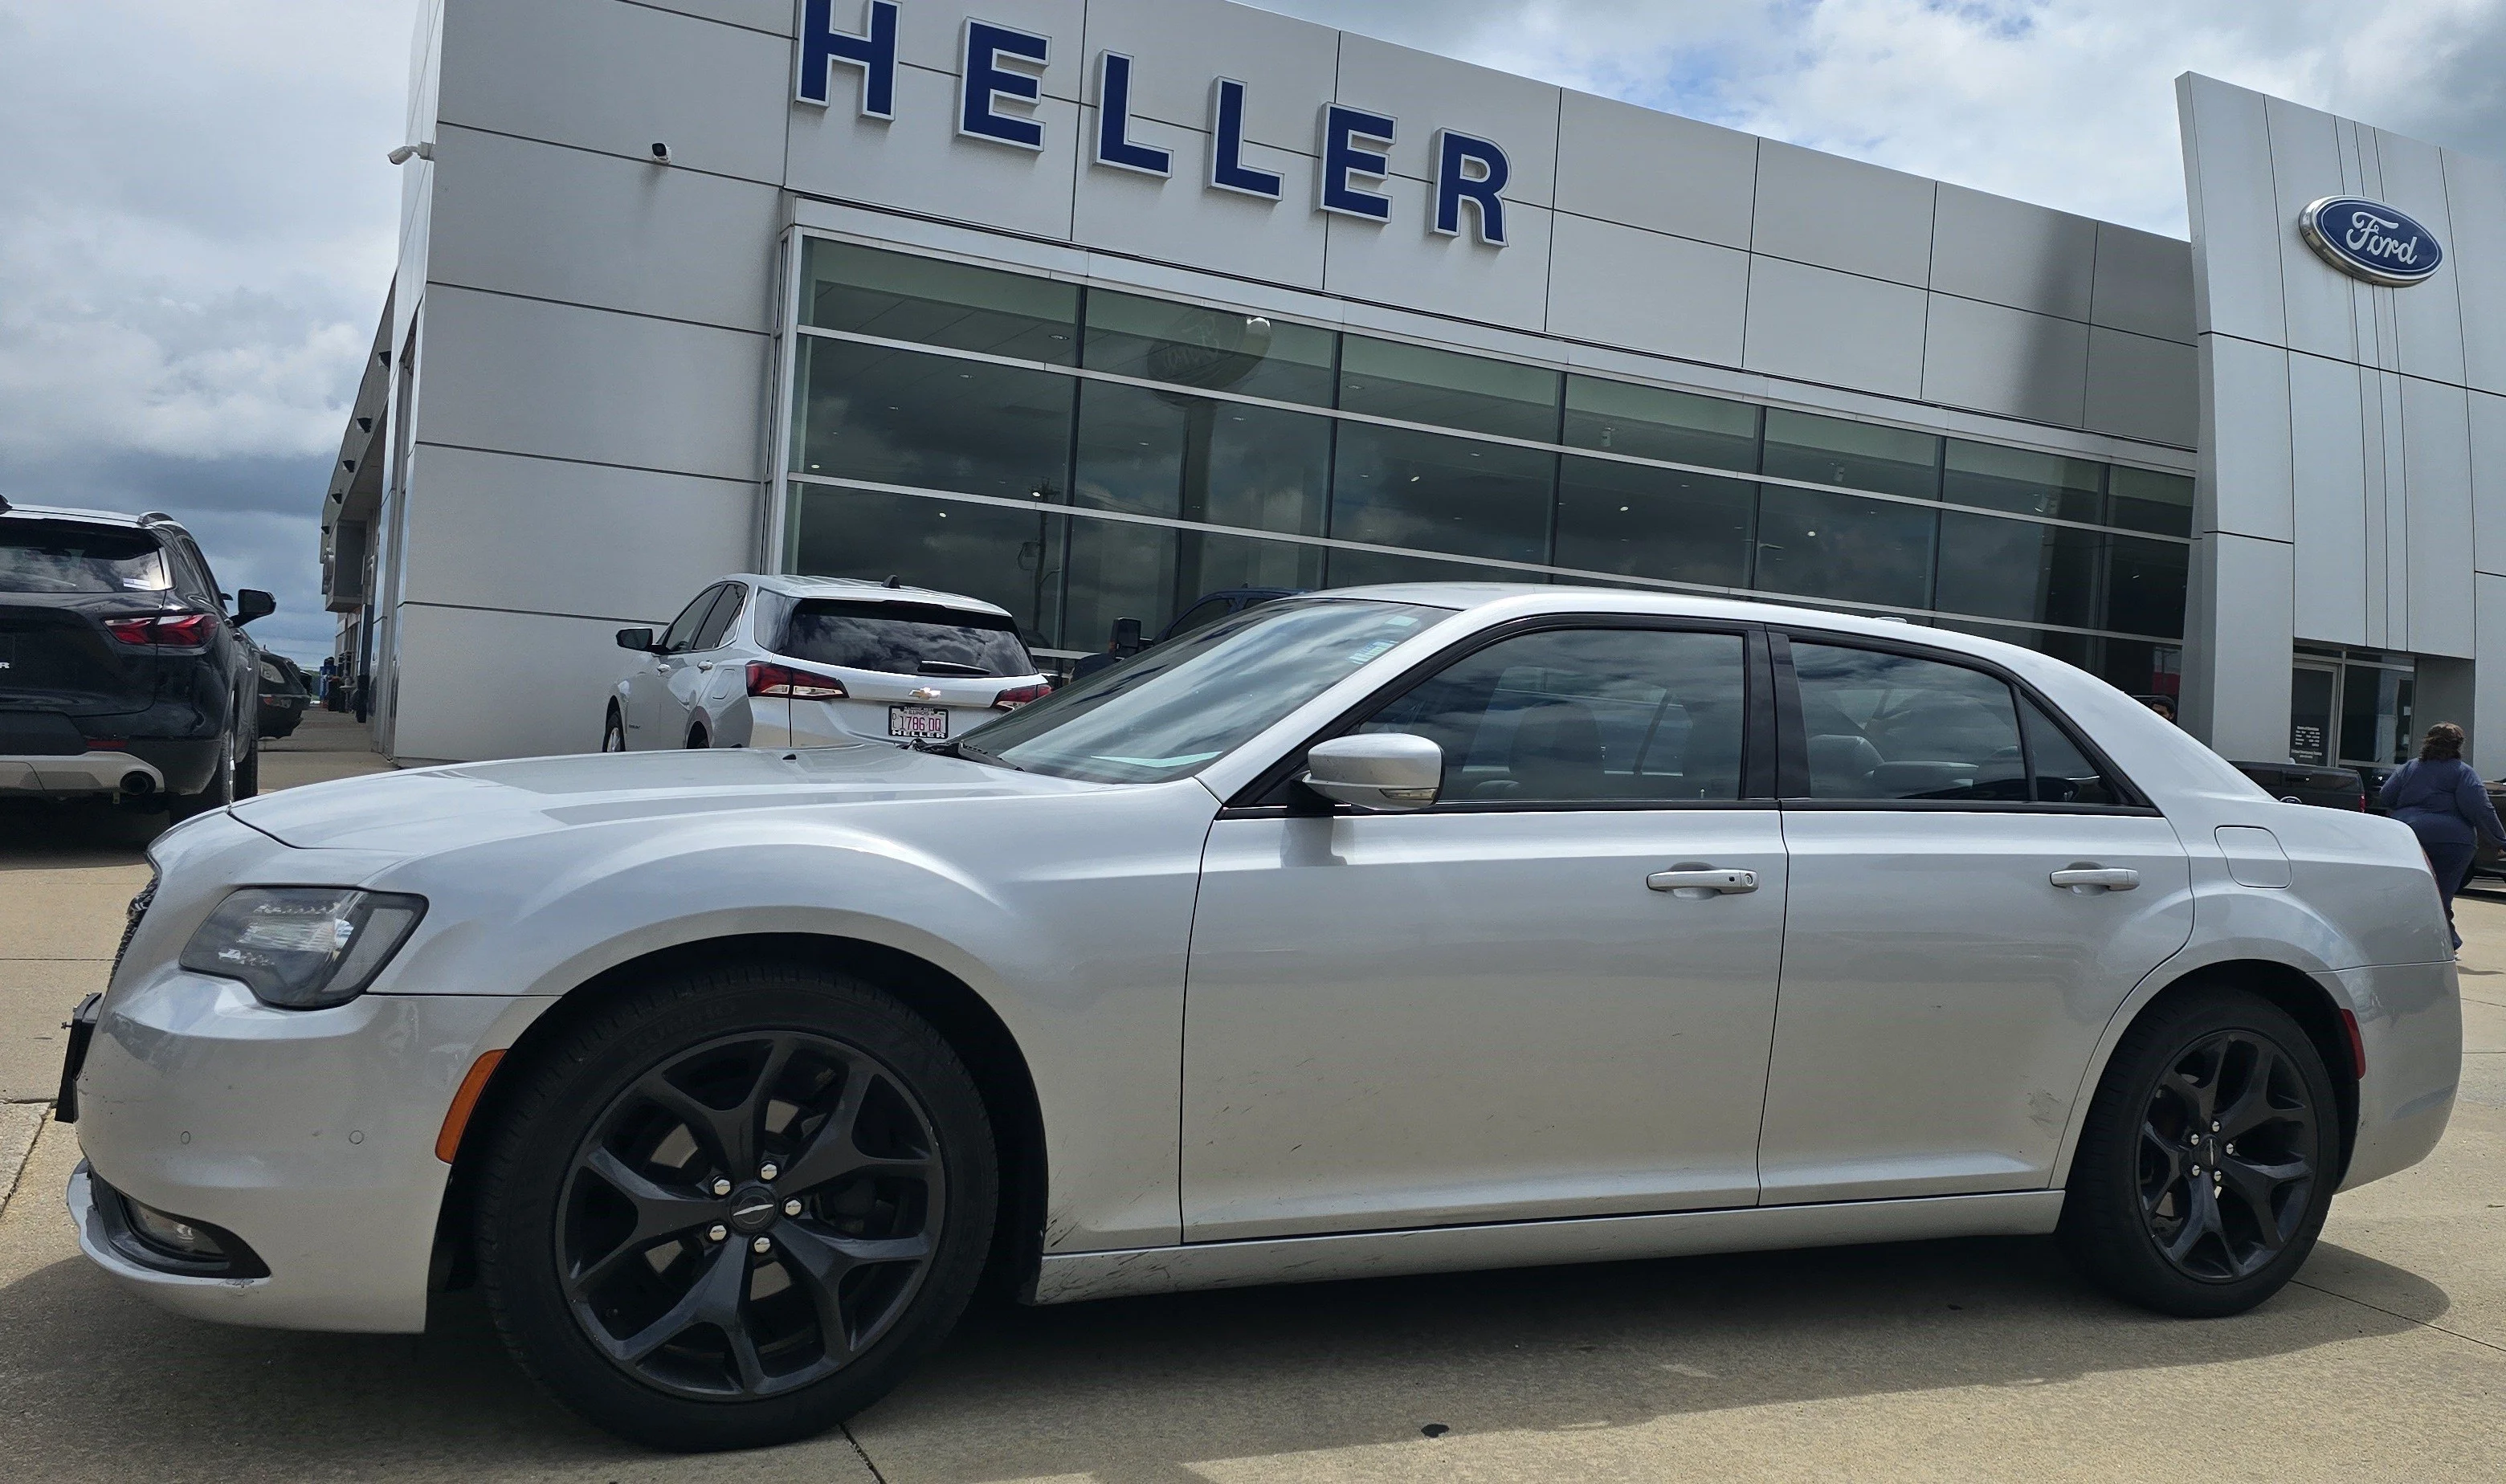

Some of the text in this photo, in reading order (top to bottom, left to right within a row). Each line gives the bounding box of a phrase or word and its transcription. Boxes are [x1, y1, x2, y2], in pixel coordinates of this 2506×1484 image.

[794, 0, 1514, 248] HELLER
[2345, 211, 2418, 265] Ford
[892, 729, 945, 739] HELLER
[900, 716, 925, 731] 1786
